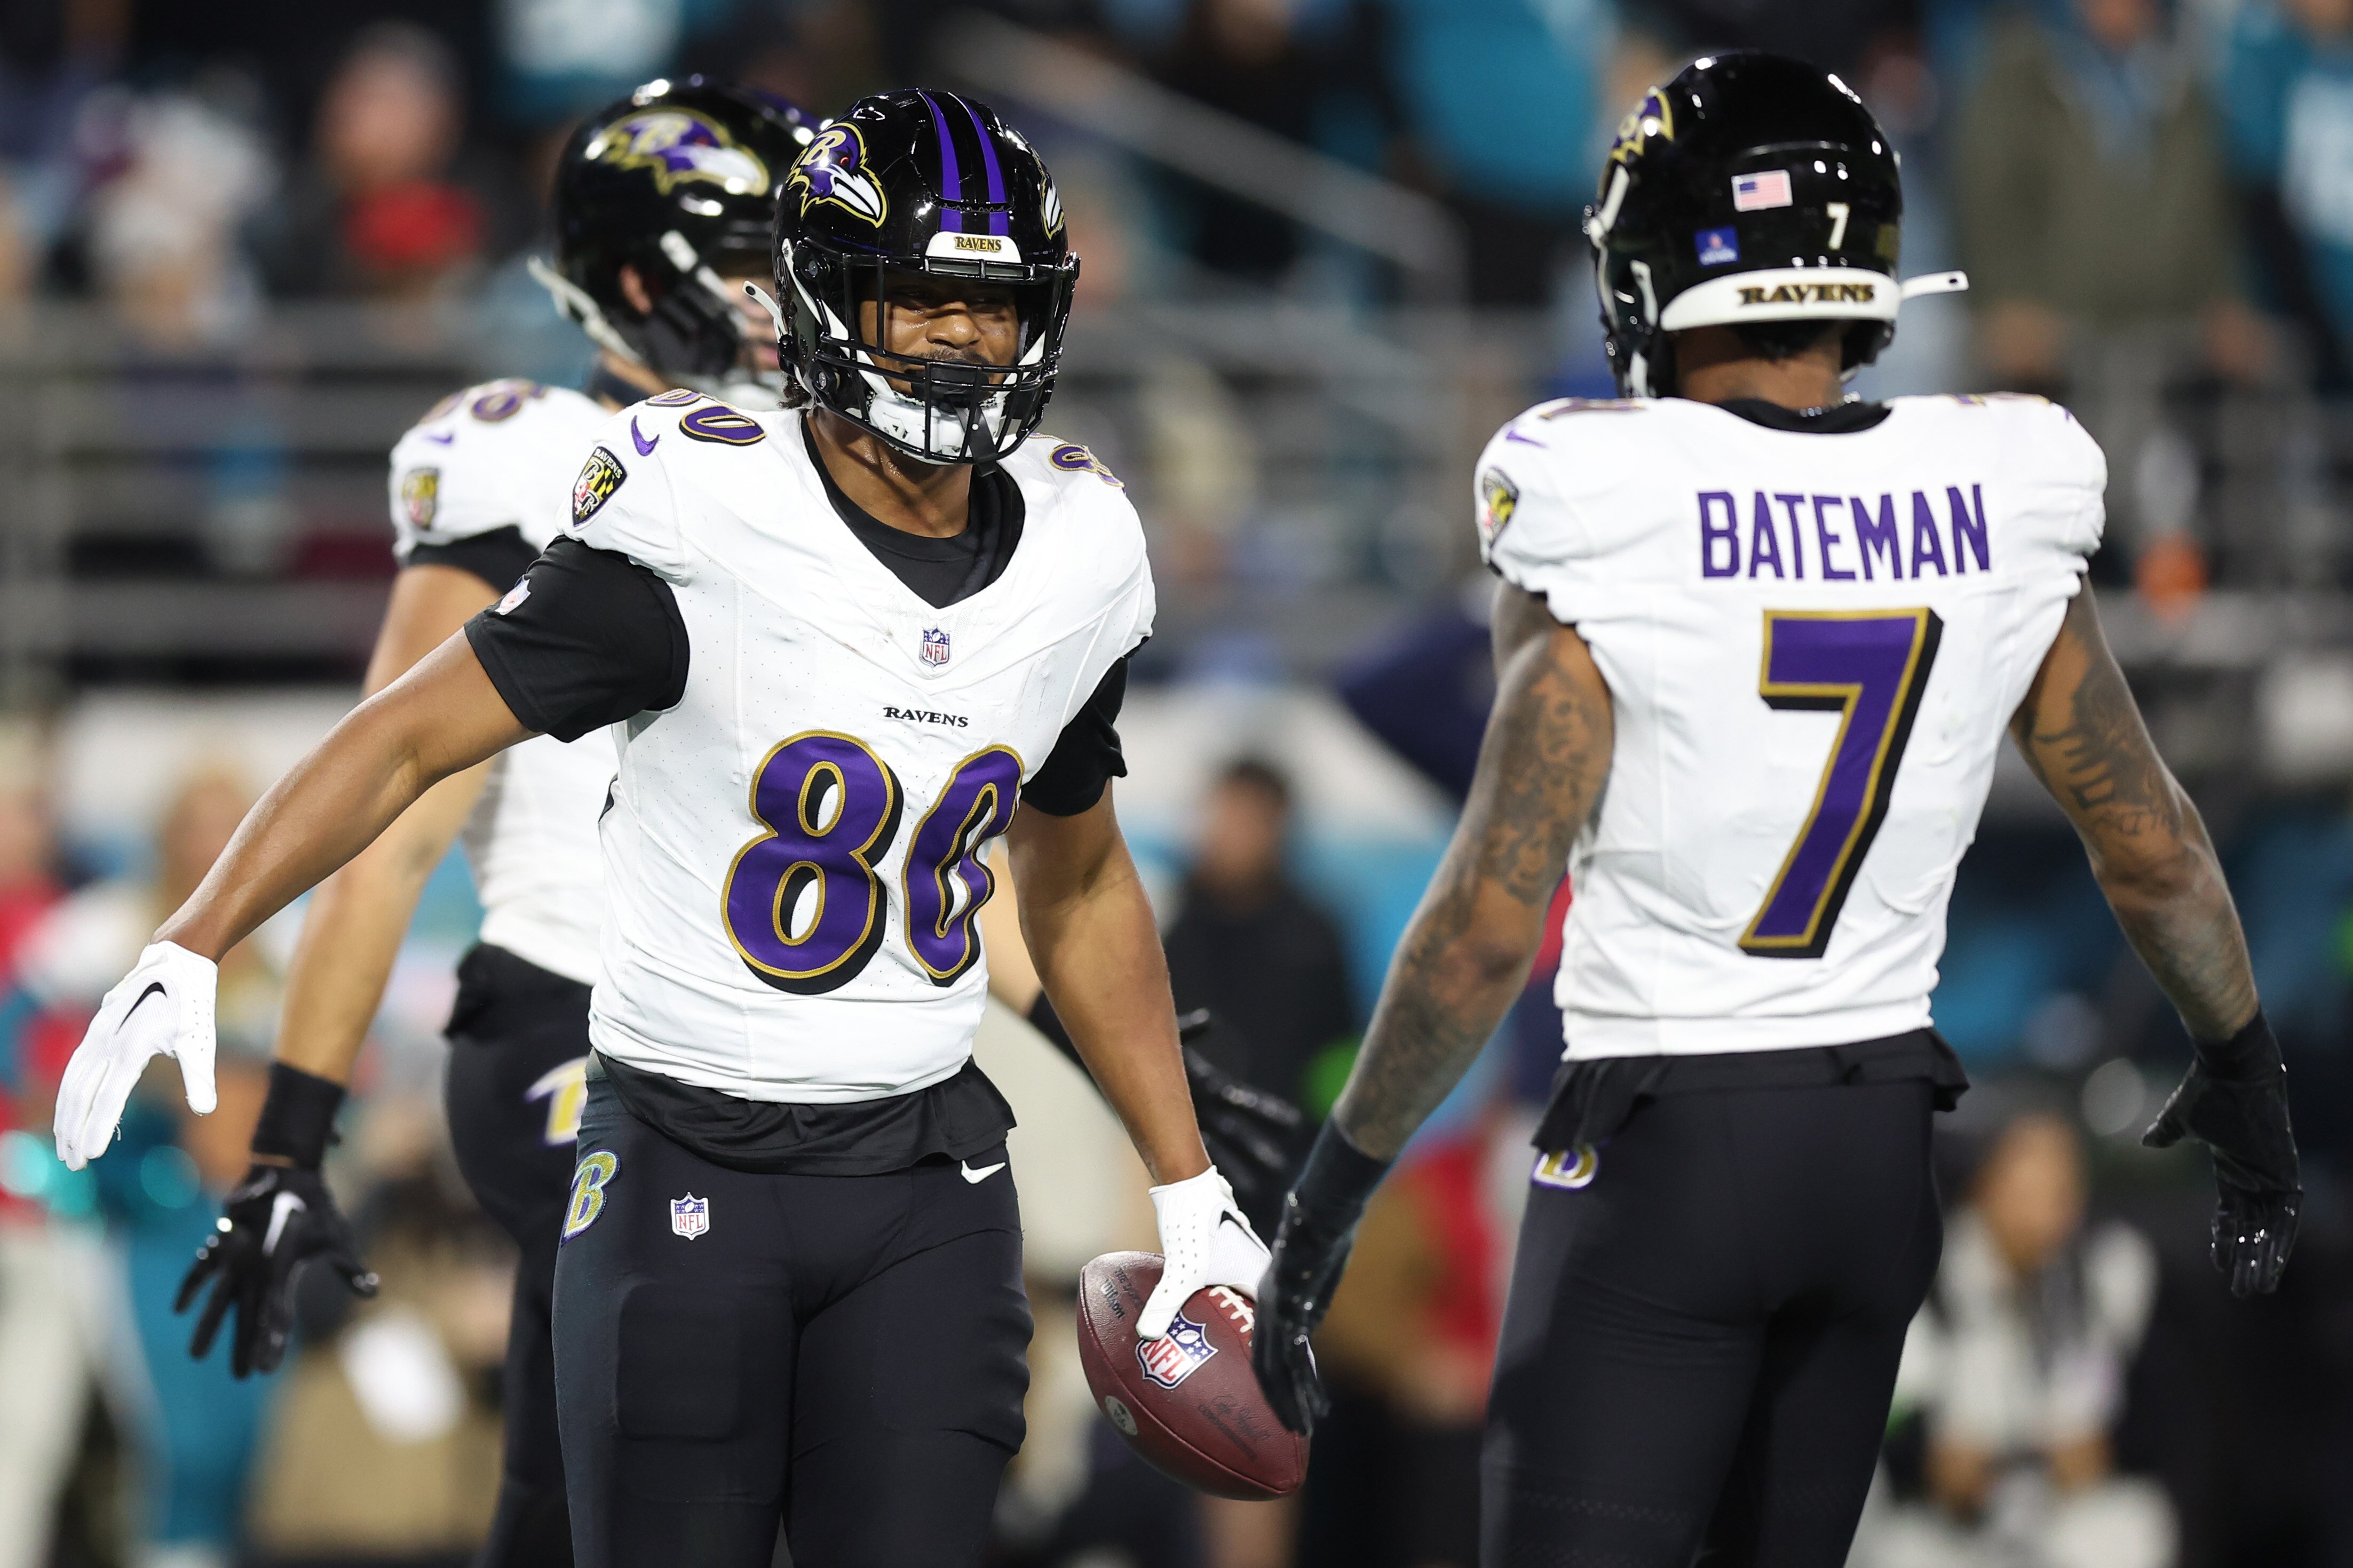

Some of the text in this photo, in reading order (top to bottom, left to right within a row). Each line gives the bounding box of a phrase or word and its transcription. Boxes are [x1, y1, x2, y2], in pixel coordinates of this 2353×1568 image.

[800, 130, 846, 165] B
[1826, 202, 1850, 251] 7
[954, 236, 1002, 253] RAVENS
[1738, 283, 1875, 305] RAVENS
[594, 449, 623, 479] RAVENS
[1697, 483, 1992, 581] BATEMAN
[925, 643, 947, 662] NFL
[883, 706, 969, 728] RAVENS
[1738, 607, 1944, 959] 7
[720, 729, 1026, 995] 80
[561, 1149, 621, 1246] B
[678, 1214, 703, 1231] NFL
[1142, 1338, 1186, 1382] NFL
